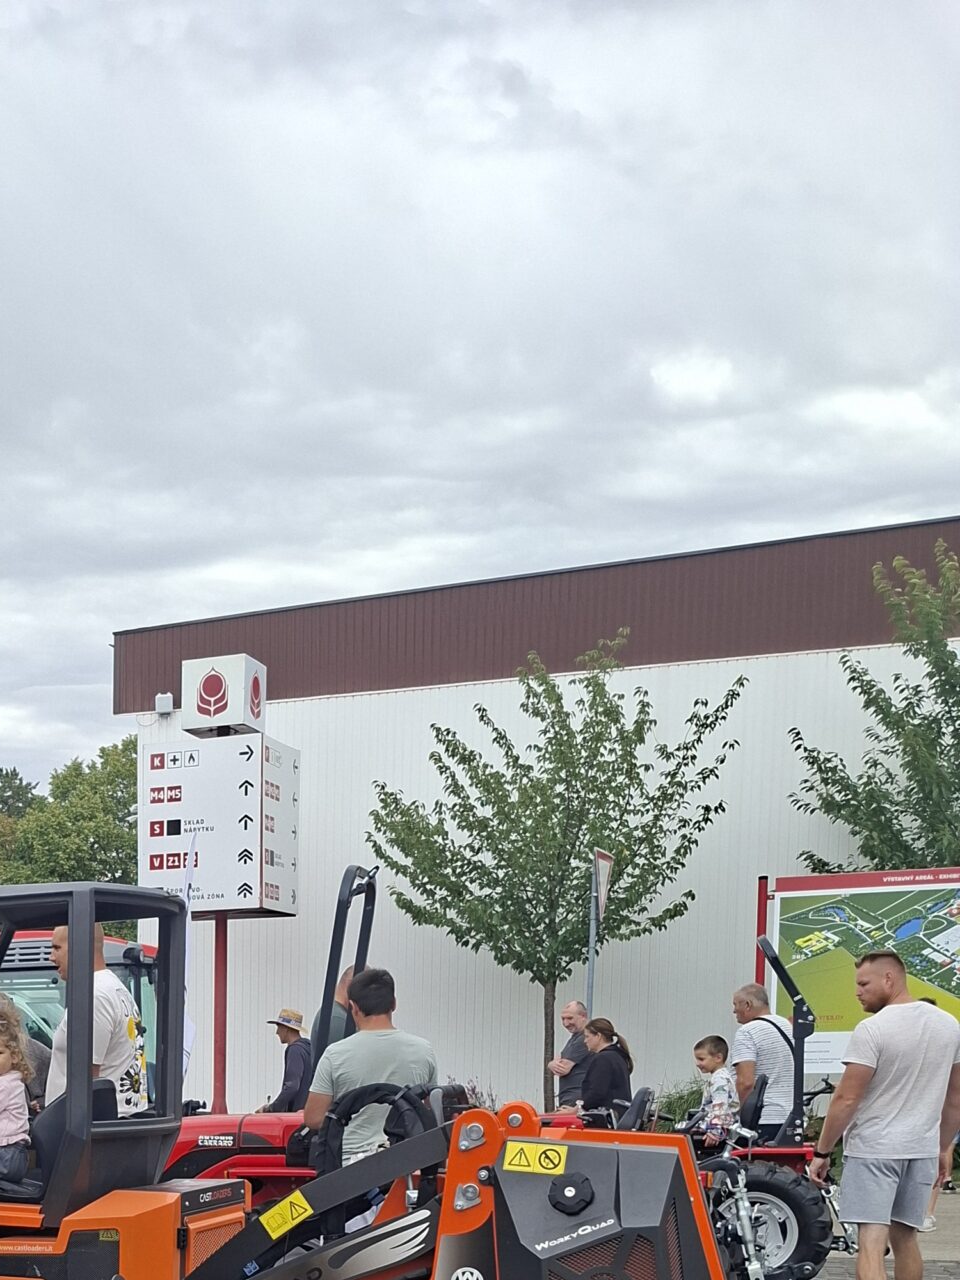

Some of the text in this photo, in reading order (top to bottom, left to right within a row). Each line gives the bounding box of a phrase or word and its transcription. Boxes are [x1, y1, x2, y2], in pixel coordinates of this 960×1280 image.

[153, 757, 161, 768] K
[150, 788, 181, 801] M4 M5
[153, 824, 161, 834] S
[152, 857, 161, 868] V
[167, 856, 180, 866] Z1
